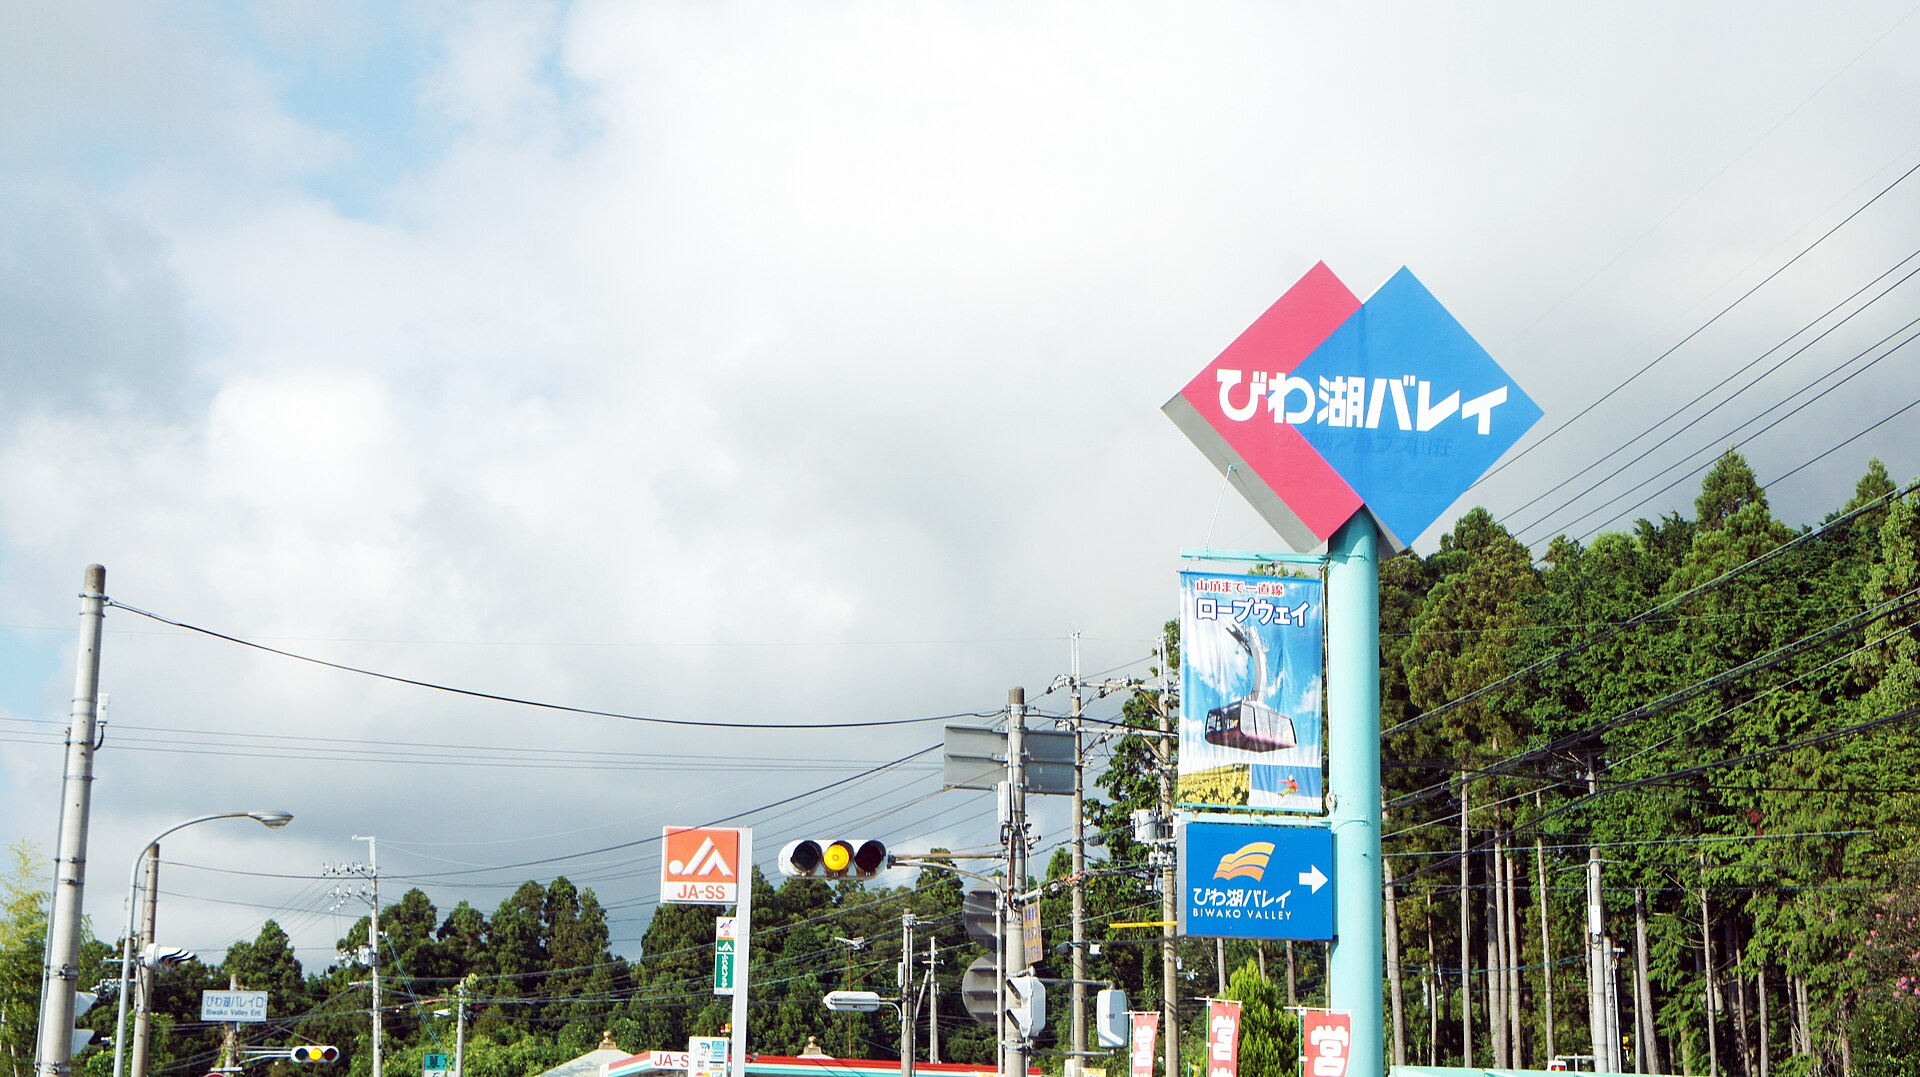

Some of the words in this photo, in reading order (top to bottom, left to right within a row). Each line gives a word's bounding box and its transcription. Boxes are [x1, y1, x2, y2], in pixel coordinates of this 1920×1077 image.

[1216, 368, 1508, 435] びわ湖バレイ
[1195, 579, 1285, 597] 山頂まで一直線
[1196, 597, 1311, 627] ロープウェイ
[677, 884, 725, 900] JA-SS
[1193, 888, 1292, 909] びわ湖バレイ
[1193, 908, 1242, 919] BIWAKO
[1247, 909, 1292, 921] VALLEY
[206, 1008, 228, 1016] Biwako
[230, 1009, 248, 1018] Valley
[1133, 1025, 1154, 1077] 営
[1211, 1015, 1236, 1077] 営
[654, 1053, 689, 1068] JA-S
